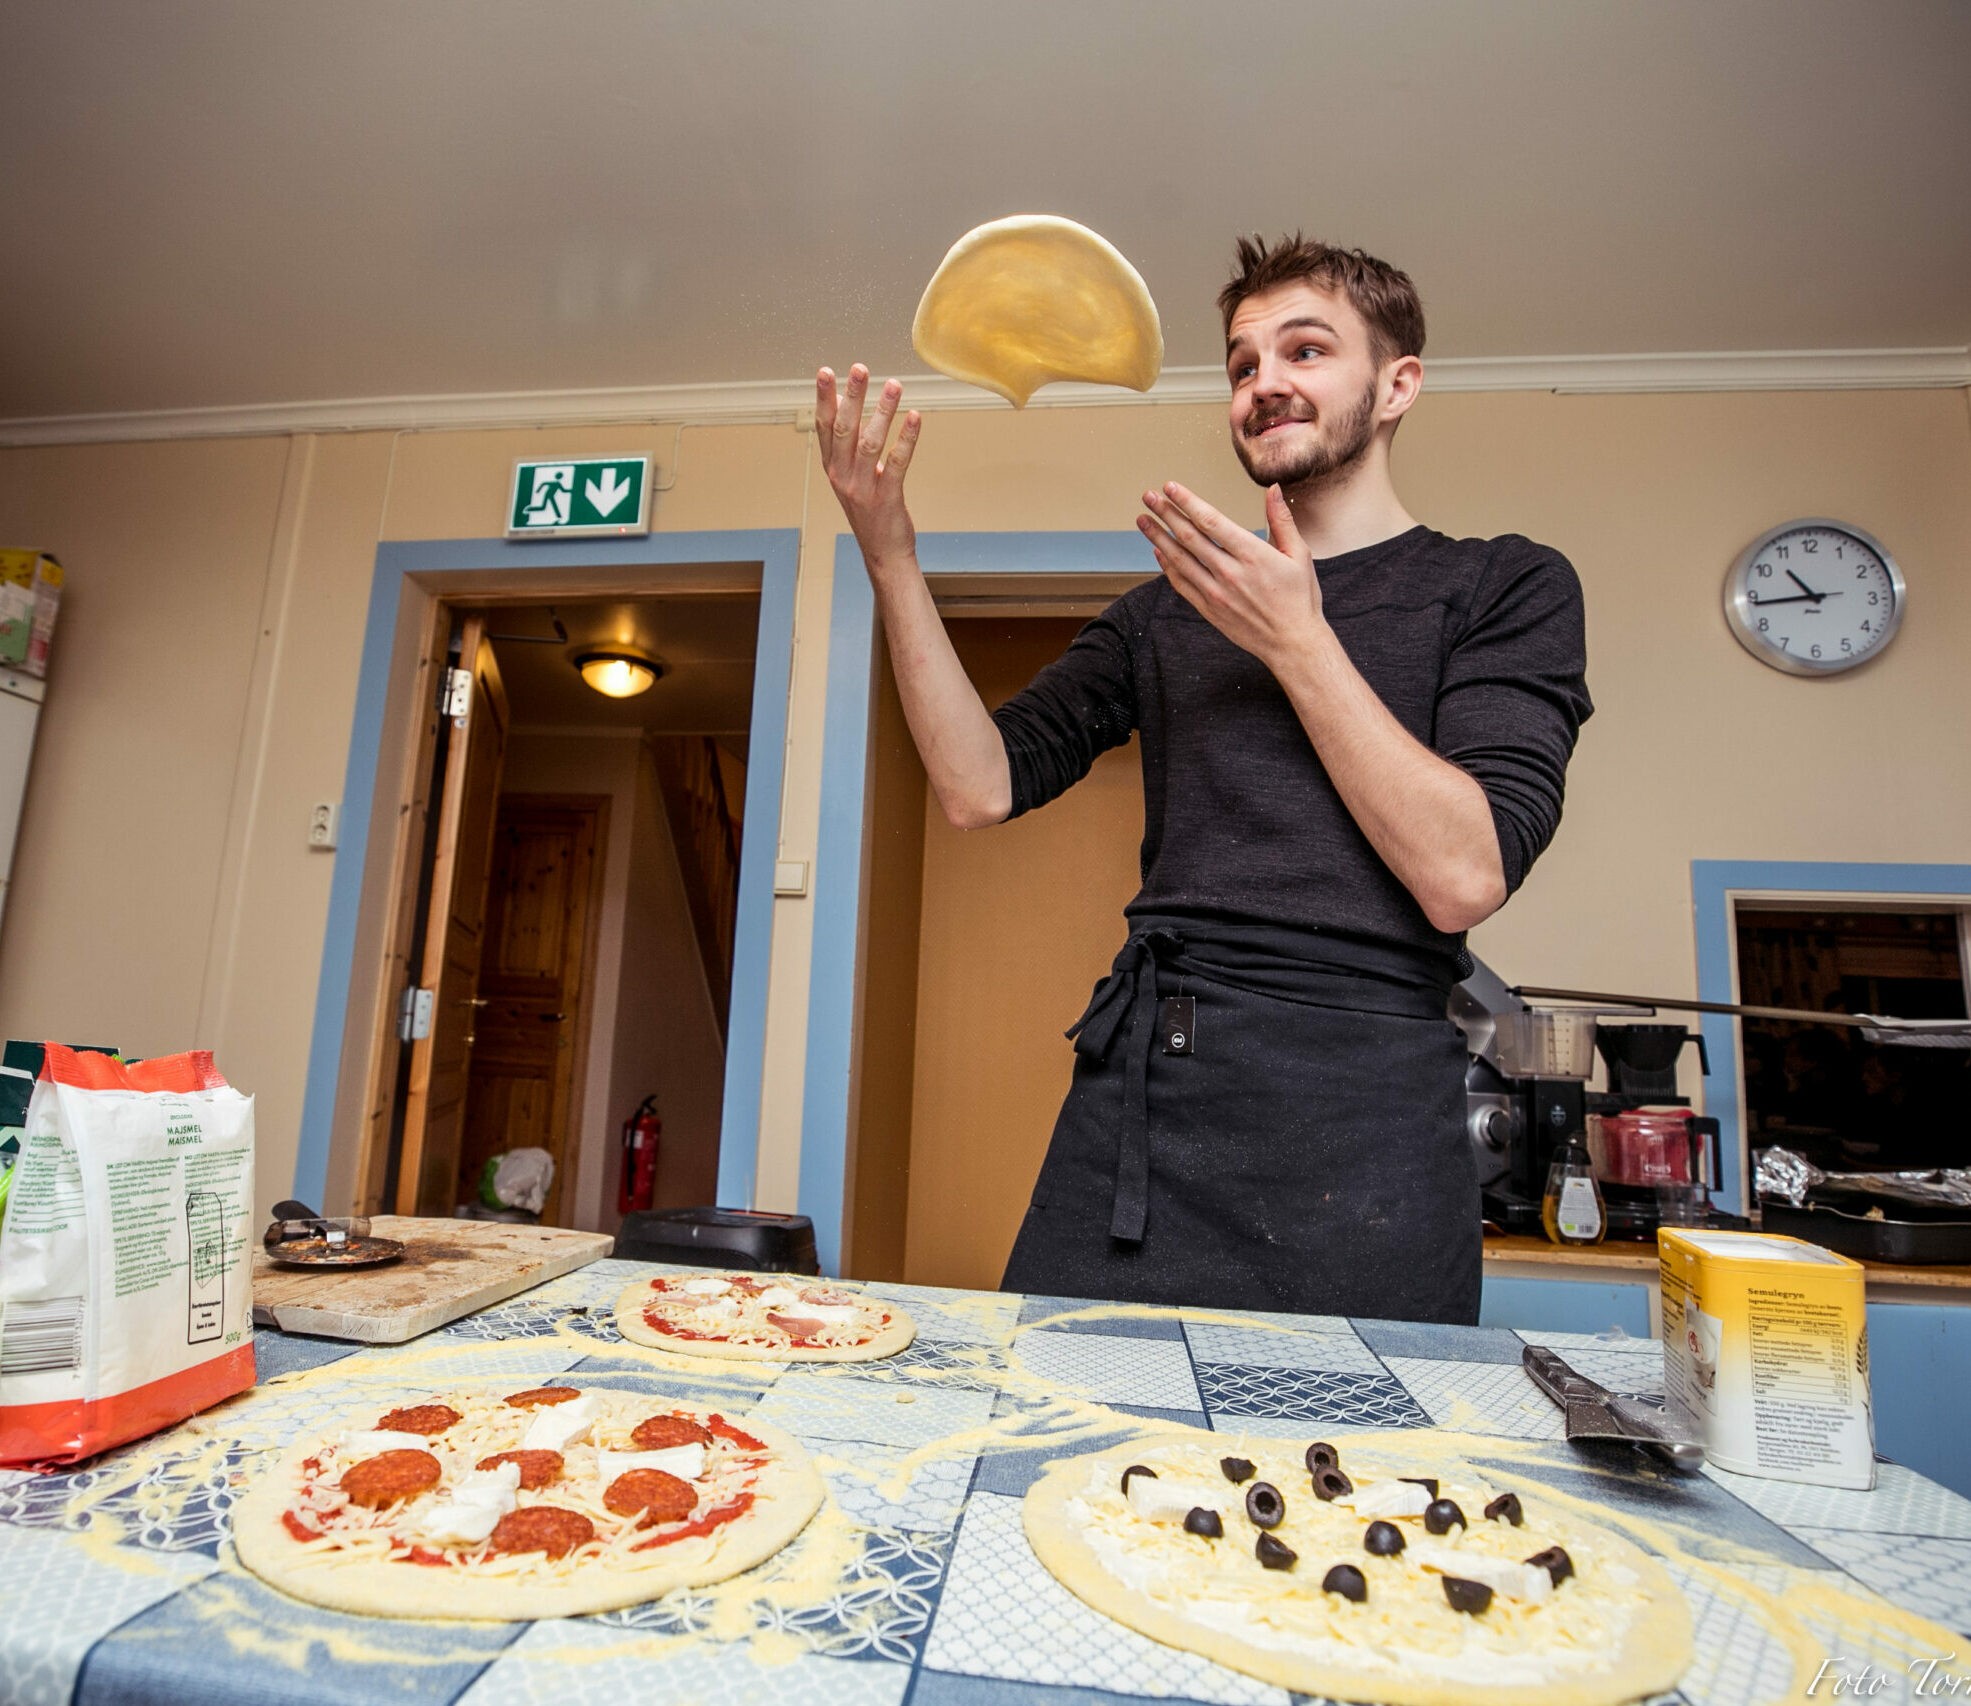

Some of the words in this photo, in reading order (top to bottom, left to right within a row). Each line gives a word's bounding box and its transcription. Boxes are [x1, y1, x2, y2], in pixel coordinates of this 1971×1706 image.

[1776, 546, 1789, 560] 11
[1802, 539, 1818, 554] 12
[1835, 547, 1842, 560] 1
[1756, 564, 1773, 578] 10
[1856, 565, 1868, 579] 2
[1748, 590, 1759, 605] 9
[1867, 591, 1879, 606] 3
[1758, 617, 1769, 632] 8
[1860, 620, 1871, 633] 4
[1780, 637, 1790, 650] 7
[1841, 638, 1852, 652] 5
[1811, 644, 1822, 658] 6
[167, 1124, 203, 1135] MAJSMEL
[167, 1135, 203, 1147] MAISMEL
[1747, 1288, 1805, 1299] Semulegryn
